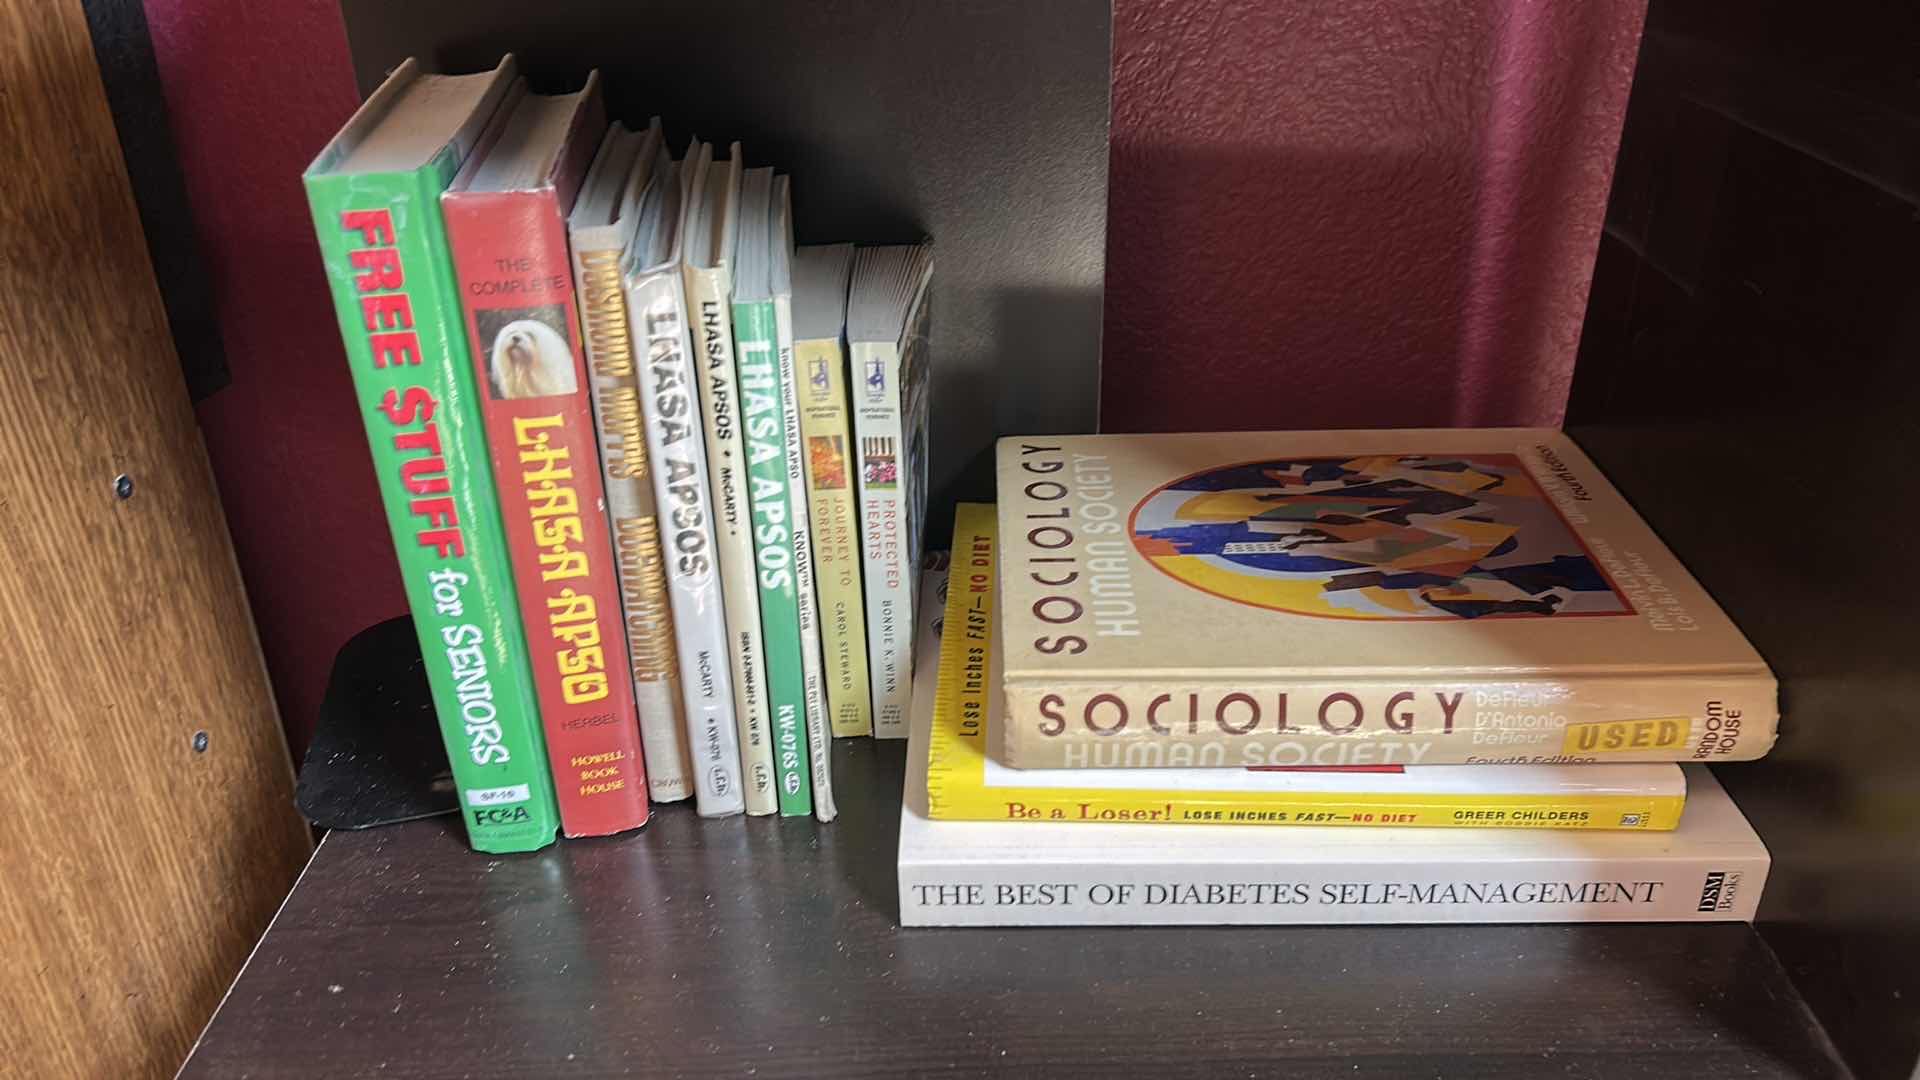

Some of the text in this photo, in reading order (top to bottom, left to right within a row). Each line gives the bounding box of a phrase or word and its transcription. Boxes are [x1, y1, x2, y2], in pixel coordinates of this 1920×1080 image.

[470, 274, 566, 295] COMPLETE
[496, 258, 530, 273] THE
[341, 208, 424, 369] FREE
[703, 301, 737, 525] LHASA APSOS McCARTY
[785, 410, 796, 446] LHASA
[646, 312, 709, 577] LHASA APSOS
[738, 340, 792, 590] LHASA APSOS
[789, 451, 799, 479] APSO
[817, 498, 832, 563] FOREVER
[834, 498, 852, 586] JOURNEY TO
[866, 500, 882, 560] HEARTS
[884, 500, 900, 589] PROTECTED
[972, 535, 992, 567] DIET
[1022, 444, 1088, 655] SOCIOLOGY
[1072, 453, 1142, 637] HUMAN SOCIETY
[513, 414, 609, 705] LHASA APSO
[428, 567, 469, 617] for
[835, 602, 848, 636] CAROL
[882, 600, 896, 644] BONNIE
[840, 641, 852, 691] STEWARD
[884, 661, 897, 693] WINN
[962, 647, 983, 694] Inches
[441, 624, 511, 766] SENIORS
[1038, 692, 1464, 736] SOCIOLOGY
[959, 700, 981, 737] Lose
[1577, 720, 1681, 751] USED
[1693, 700, 1722, 759] RANDOM
[1718, 709, 1742, 755] HOUSE
[581, 766, 619, 780] BOOK
[1065, 740, 1431, 767] HUMAN SOCIETY
[580, 779, 625, 795] HOUSE
[1005, 802, 1172, 821] Be a Loser!
[1184, 810, 1223, 820] LOSE
[1230, 811, 1288, 821] INCHES
[1381, 814, 1417, 822] DIET
[1454, 811, 1589, 820] GREER CHILDERS
[912, 882, 1664, 906] THE BEST OF DIABETES SELF-MANAGEMENT
[1700, 876, 1724, 909] DSM
[1717, 874, 1742, 909] Books
